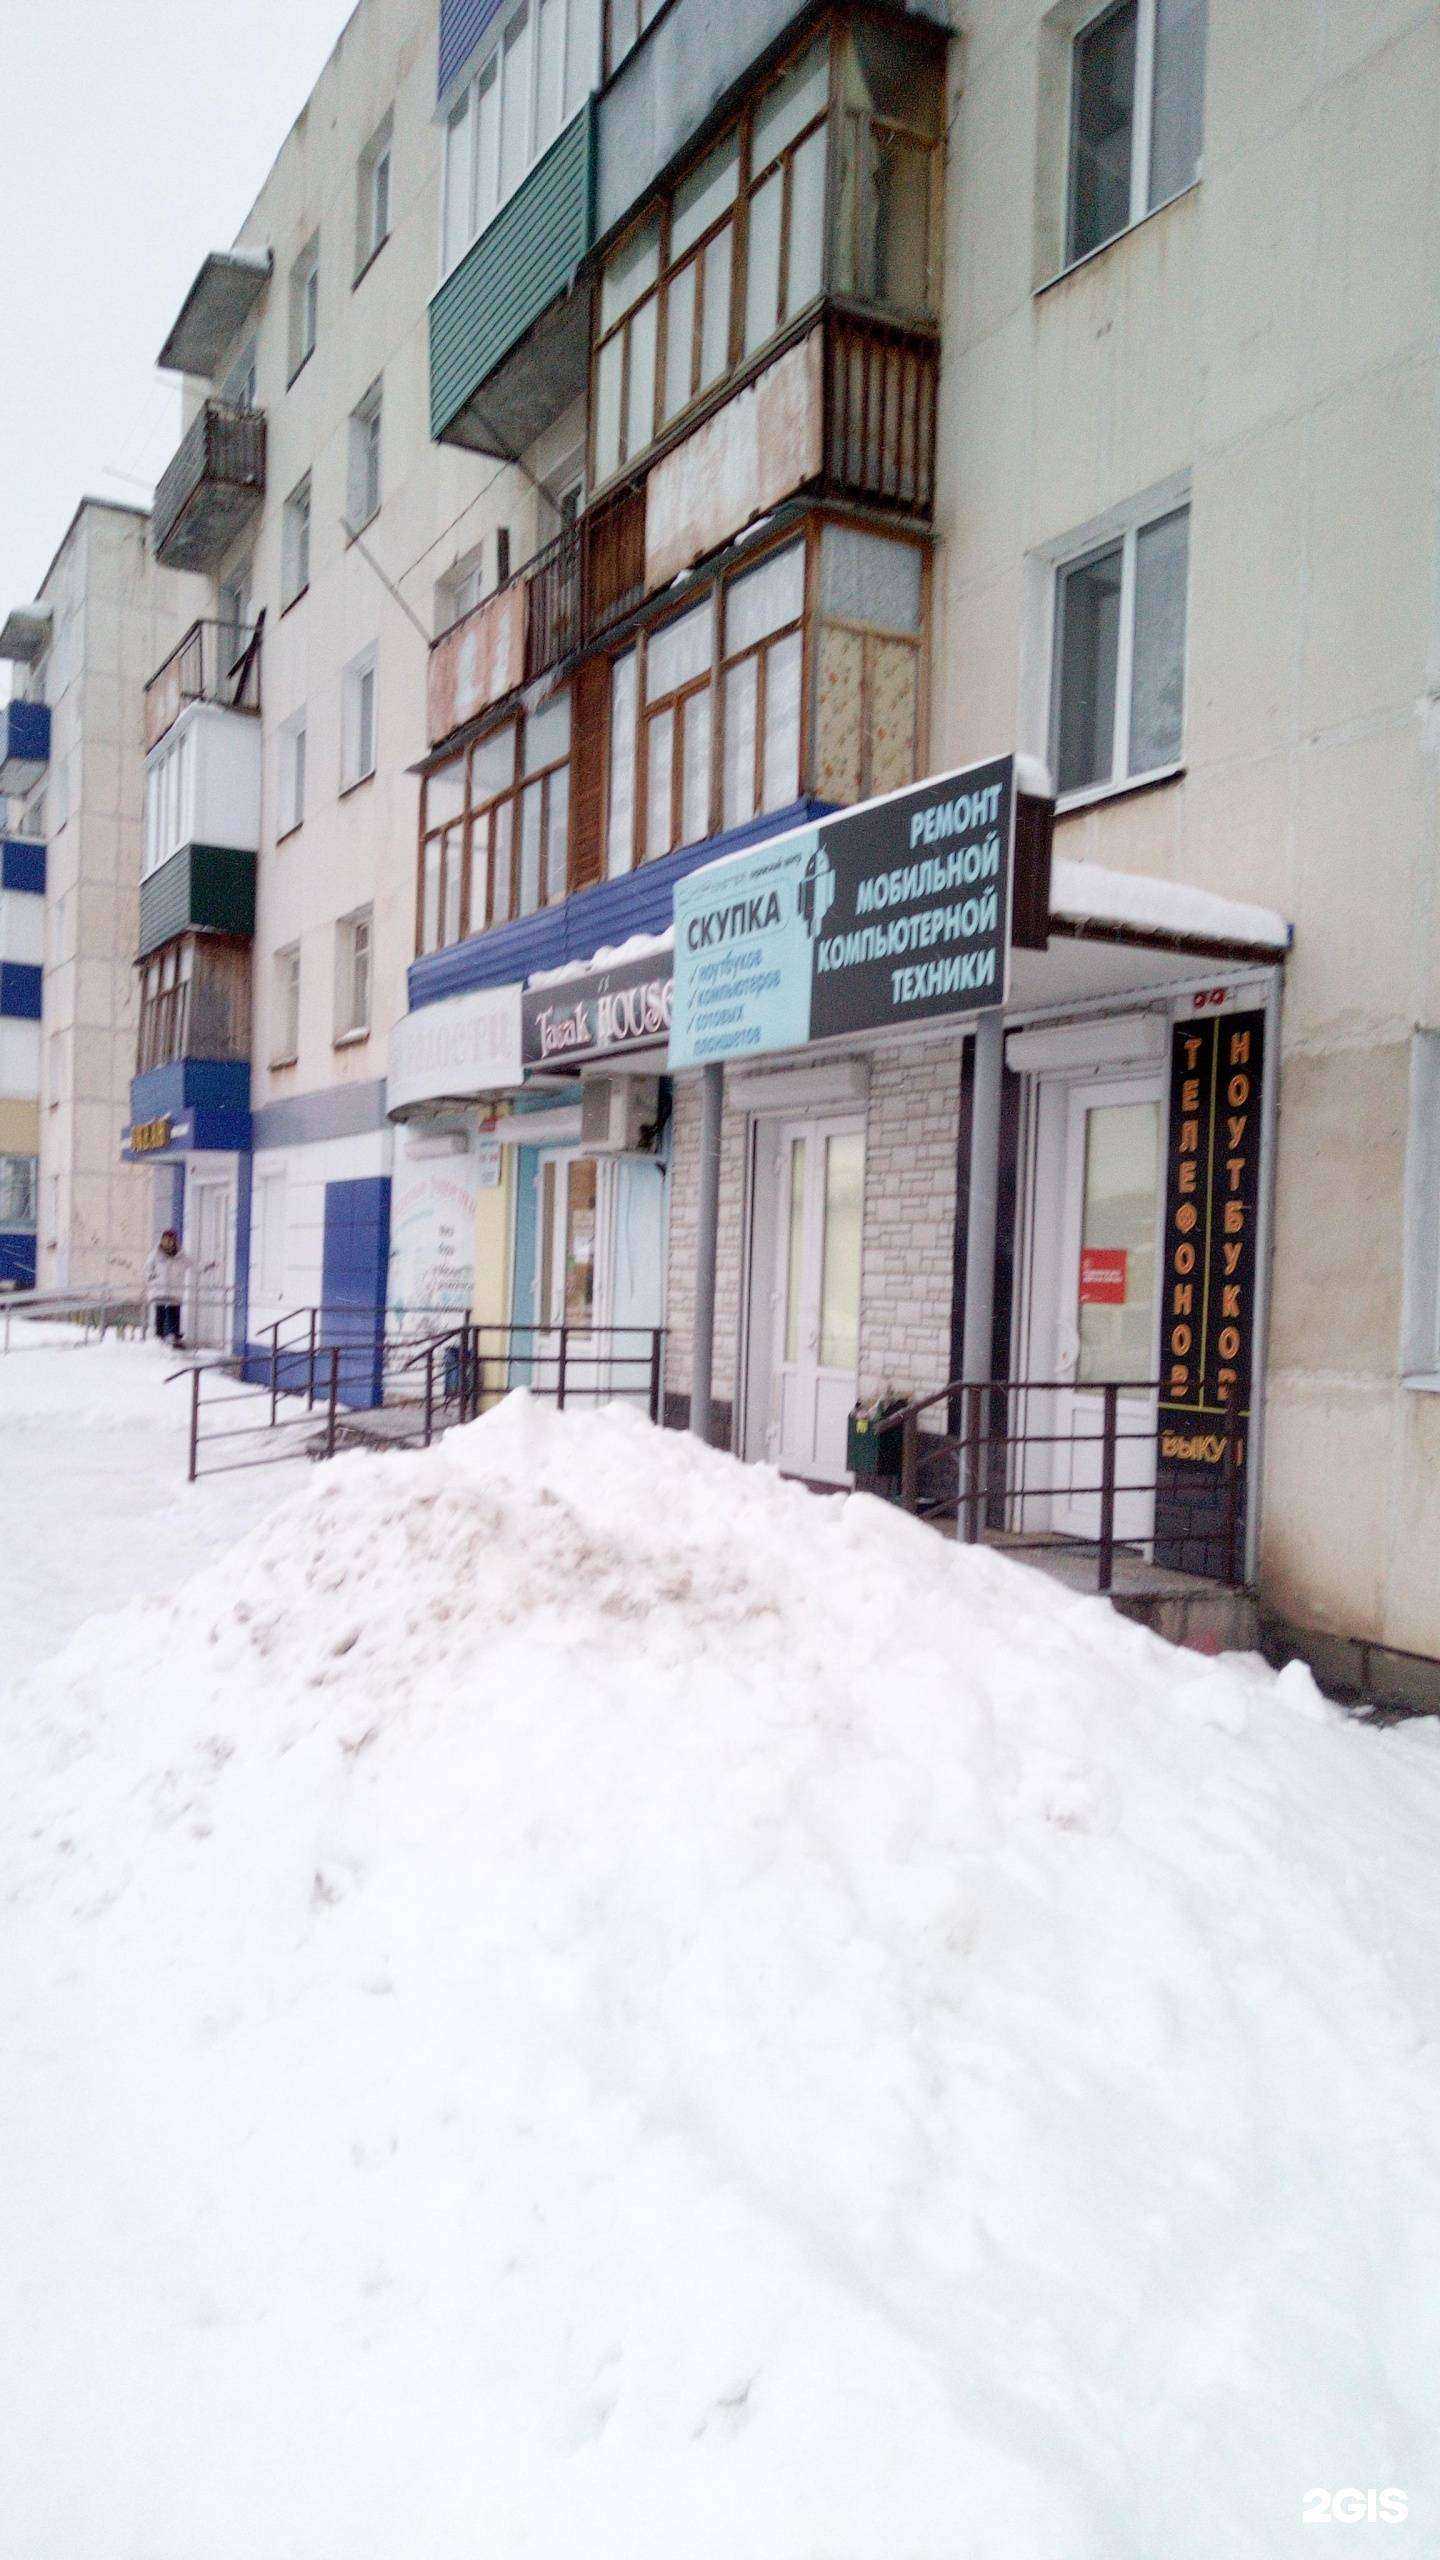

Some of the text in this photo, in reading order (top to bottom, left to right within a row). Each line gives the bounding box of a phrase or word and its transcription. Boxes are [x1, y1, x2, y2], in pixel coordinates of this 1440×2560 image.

[909, 782, 1003, 849] РЕМОНТ
[855, 831, 1000, 915] МОБИЛЬНОЙ
[686, 890, 781, 953] СКУПКА
[816, 889, 999, 974] КОМПЬЮТЕРНОЙ
[890, 948, 997, 1005] ТЕХНИКИ
[1170, 1036, 1202, 1397] ТЕЛЕФОНОВ
